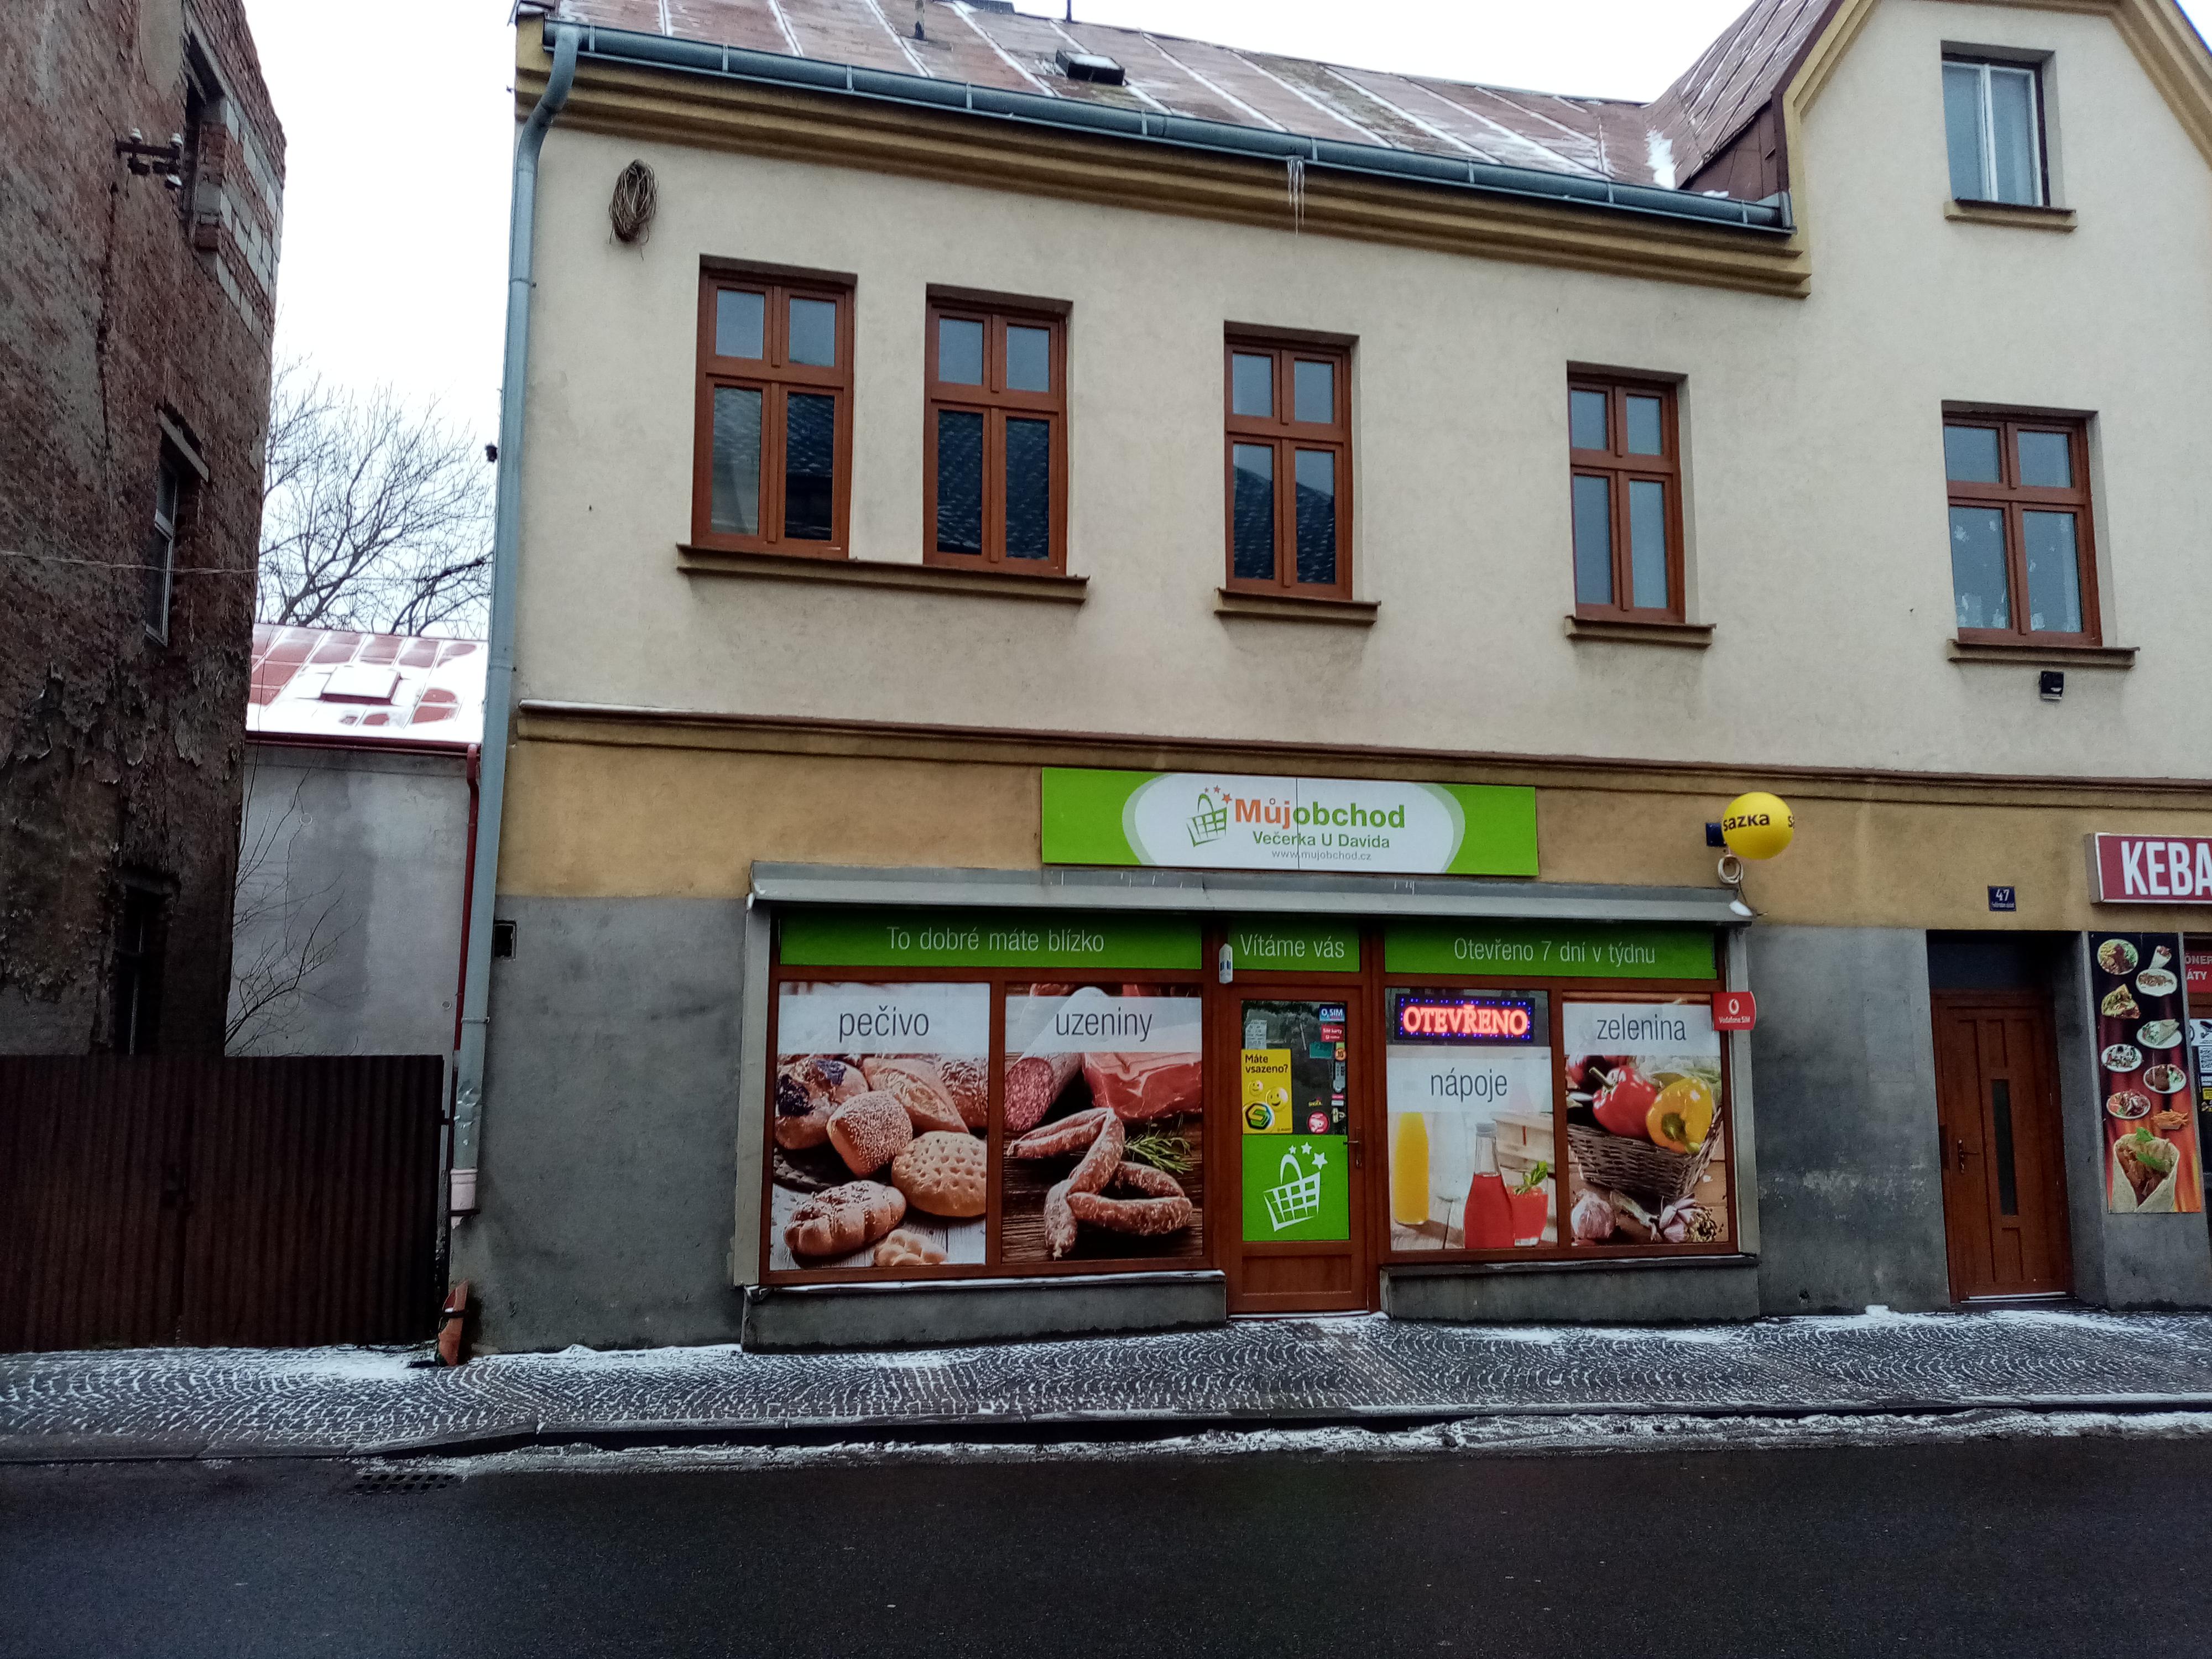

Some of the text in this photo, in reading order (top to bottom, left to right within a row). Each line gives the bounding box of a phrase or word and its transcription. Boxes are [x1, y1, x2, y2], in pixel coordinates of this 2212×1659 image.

[1723, 813, 1770, 832] sazka
[1253, 831, 1390, 848] Večerka U Davida
[1995, 888, 2010, 901] 47
[886, 926, 1104, 952] To dobré máte blízko
[1240, 933, 1345, 958] Vítáme vás
[1454, 937, 1655, 967] Otevřeno 7 dní v týdnu
[839, 1005, 930, 1043] pečivo
[1056, 1006, 1153, 1042] uzeniny
[1329, 1008, 1343, 1016] SIM
[1402, 1004, 1529, 1036] OTEVŘENO
[1597, 1013, 1687, 1041] zelenina
[1245, 1053, 1268, 1063] Máte
[1245, 1064, 1288, 1073] vsazeno?
[1430, 1068, 1507, 1103] nápoje
